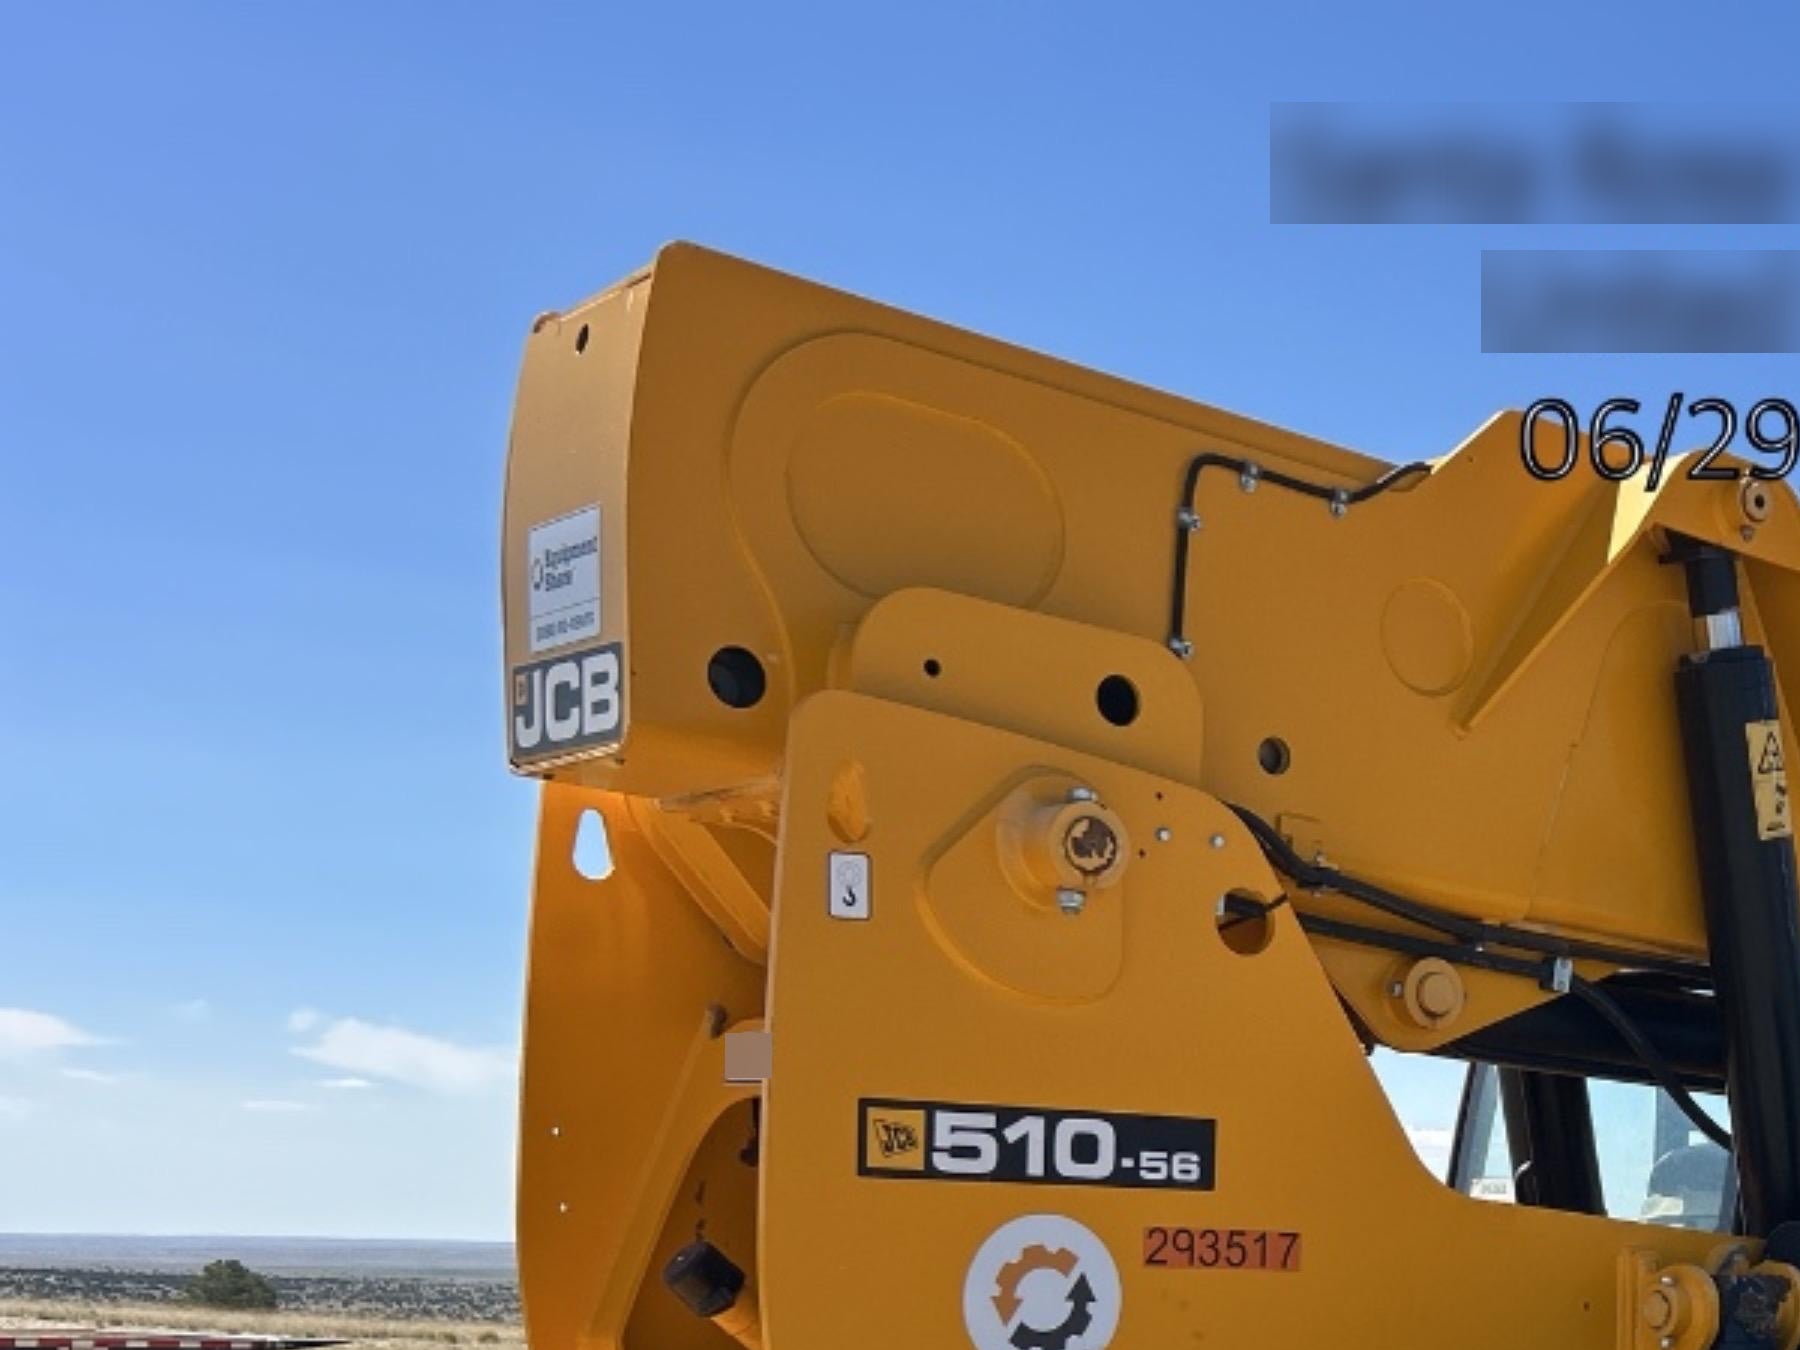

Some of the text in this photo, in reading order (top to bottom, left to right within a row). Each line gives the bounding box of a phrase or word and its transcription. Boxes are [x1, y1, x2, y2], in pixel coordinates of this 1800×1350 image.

[515, 650, 620, 749] JCB
[931, 1110, 1201, 1183] 510-56
[1143, 1227, 1300, 1268] 293517
